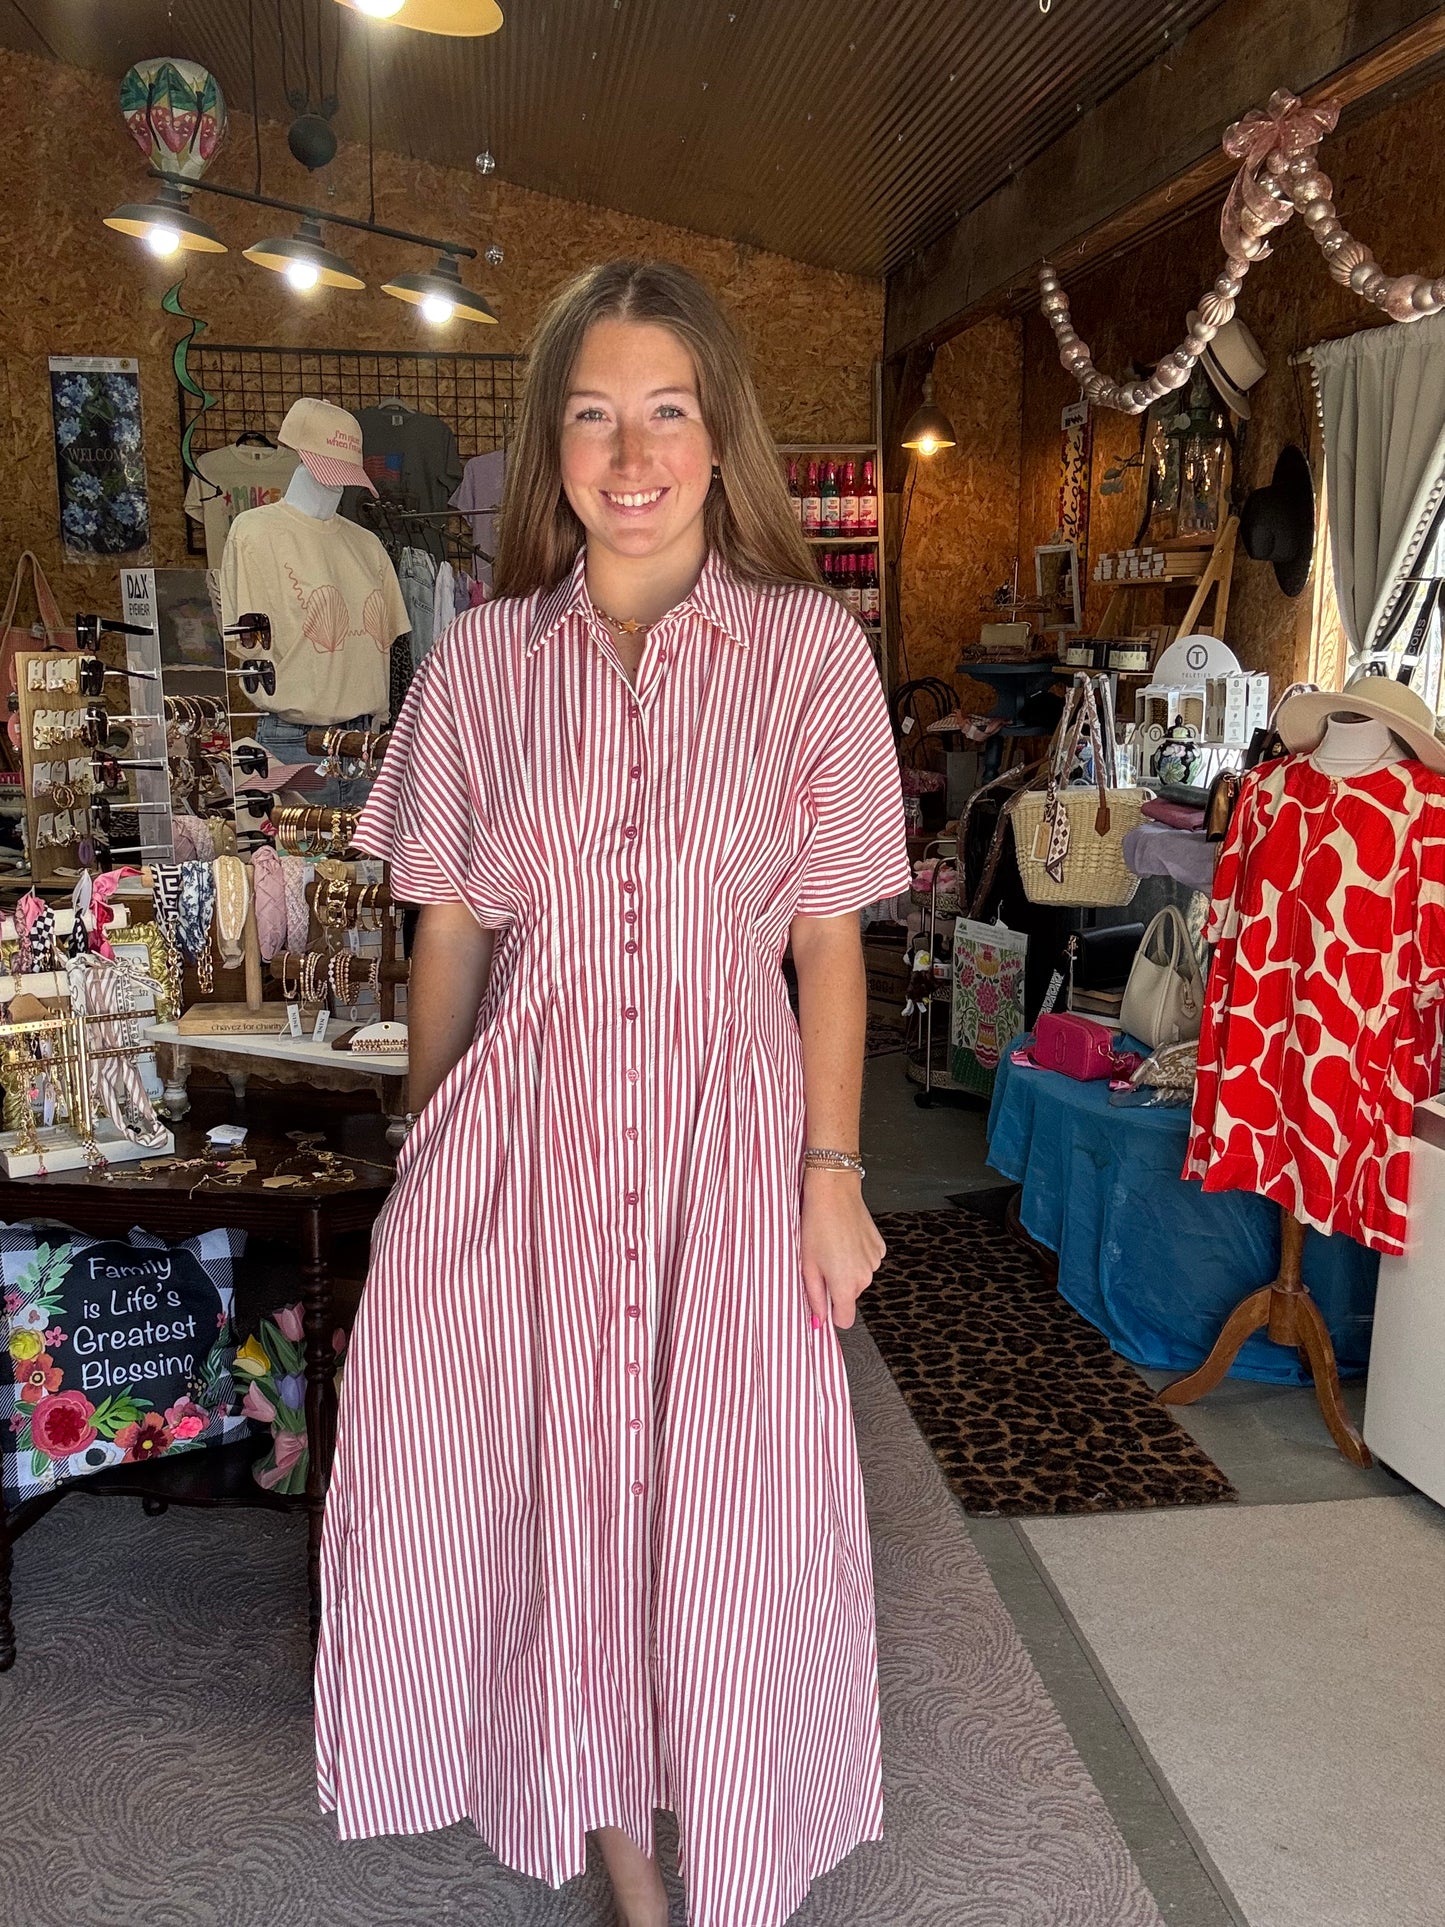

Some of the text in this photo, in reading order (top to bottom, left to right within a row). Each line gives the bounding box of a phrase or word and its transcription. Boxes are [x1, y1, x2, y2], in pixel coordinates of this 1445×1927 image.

[67, 447, 124, 462] WELCOM
[1063, 433, 1085, 544] elcome
[126, 573, 149, 599] DAX
[1407, 618, 1427, 655] COBS
[243, 1022, 255, 1031] for
[88, 1257, 172, 1280] Family
[83, 1283, 182, 1319] is Life's
[73, 1315, 197, 1356] Greatest
[81, 1352, 195, 1391] Blessing
